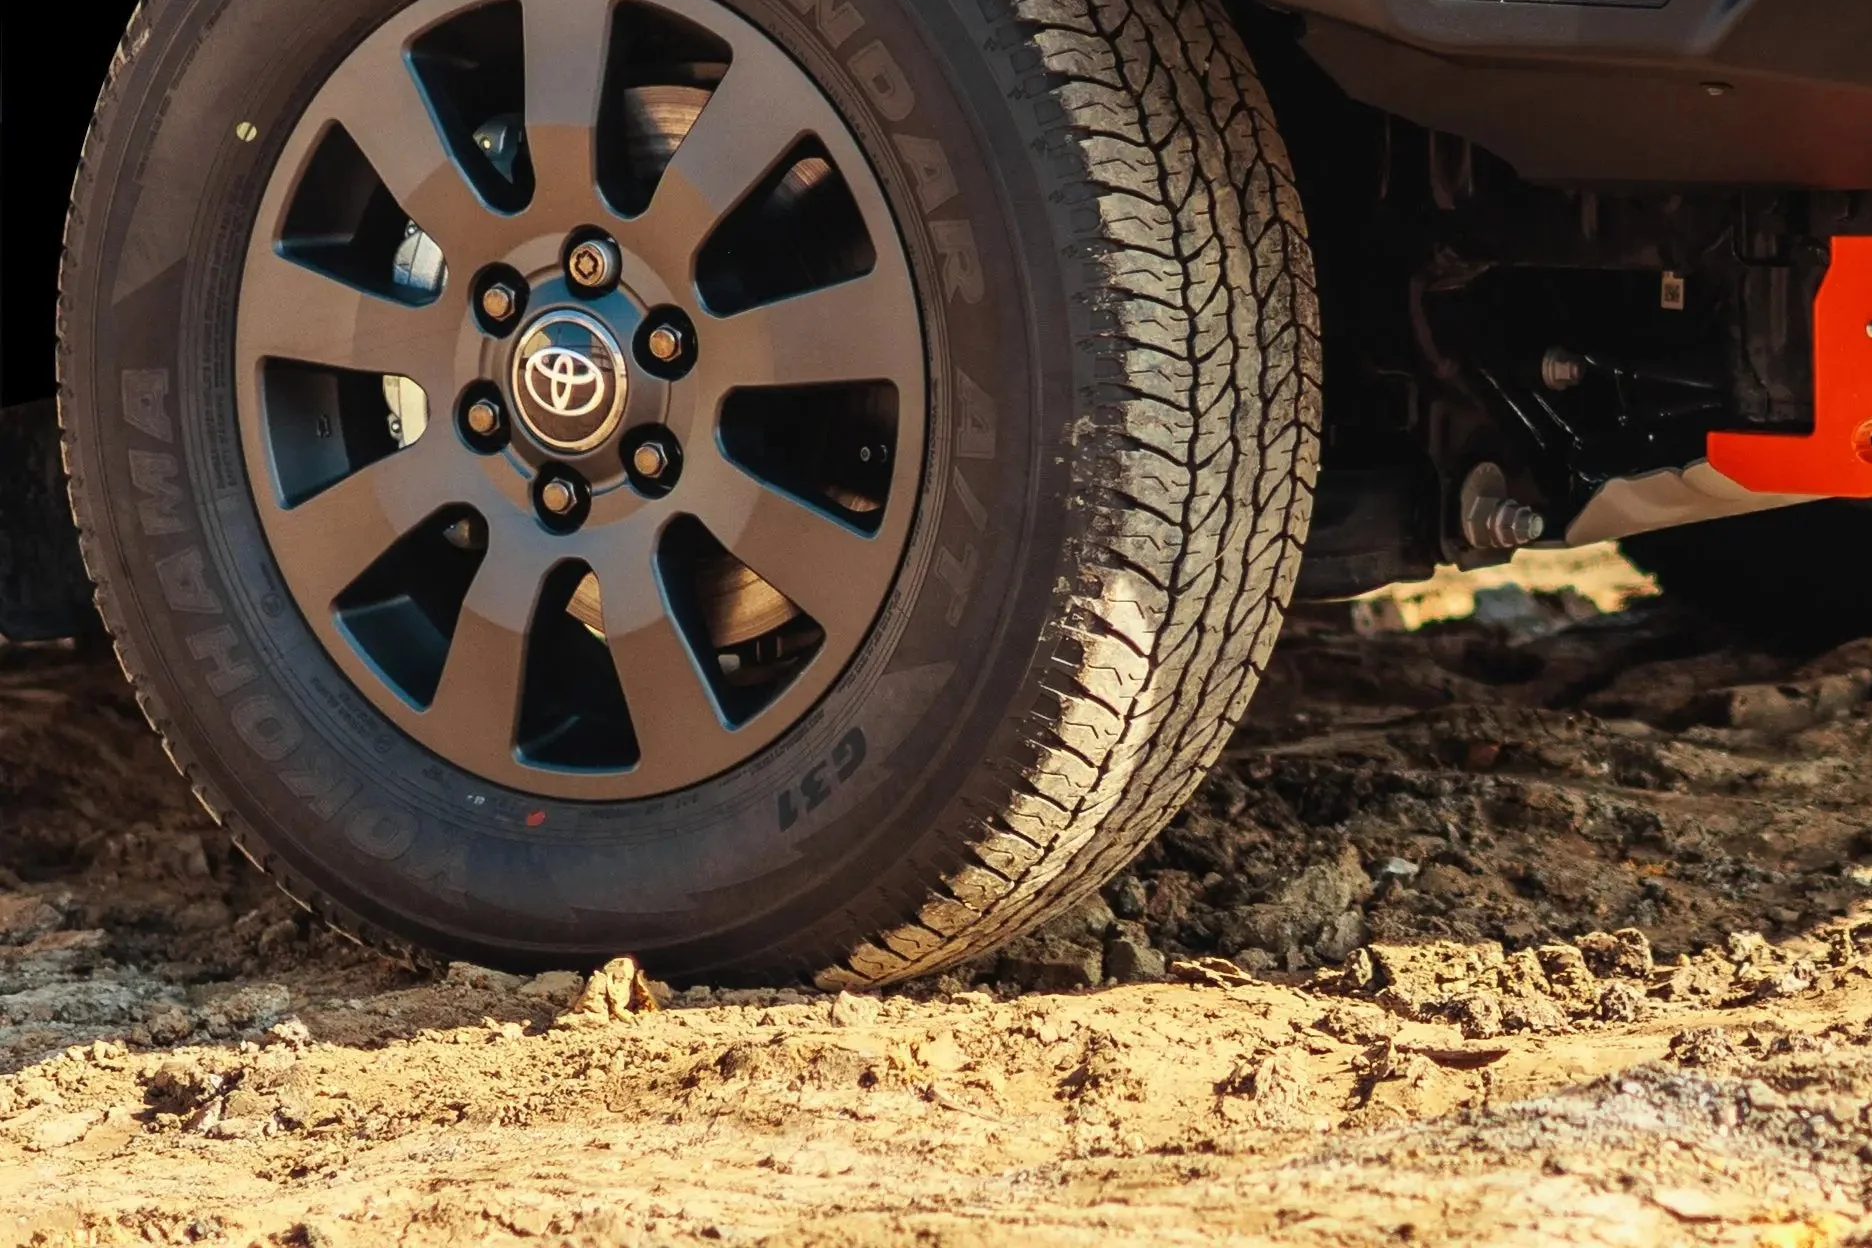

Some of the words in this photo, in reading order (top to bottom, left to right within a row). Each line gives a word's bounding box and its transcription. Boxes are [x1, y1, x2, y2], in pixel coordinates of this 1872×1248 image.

[936, 366, 997, 629] A/T
[120, 366, 471, 910] YOKOHAMA
[778, 726, 867, 833] G31
